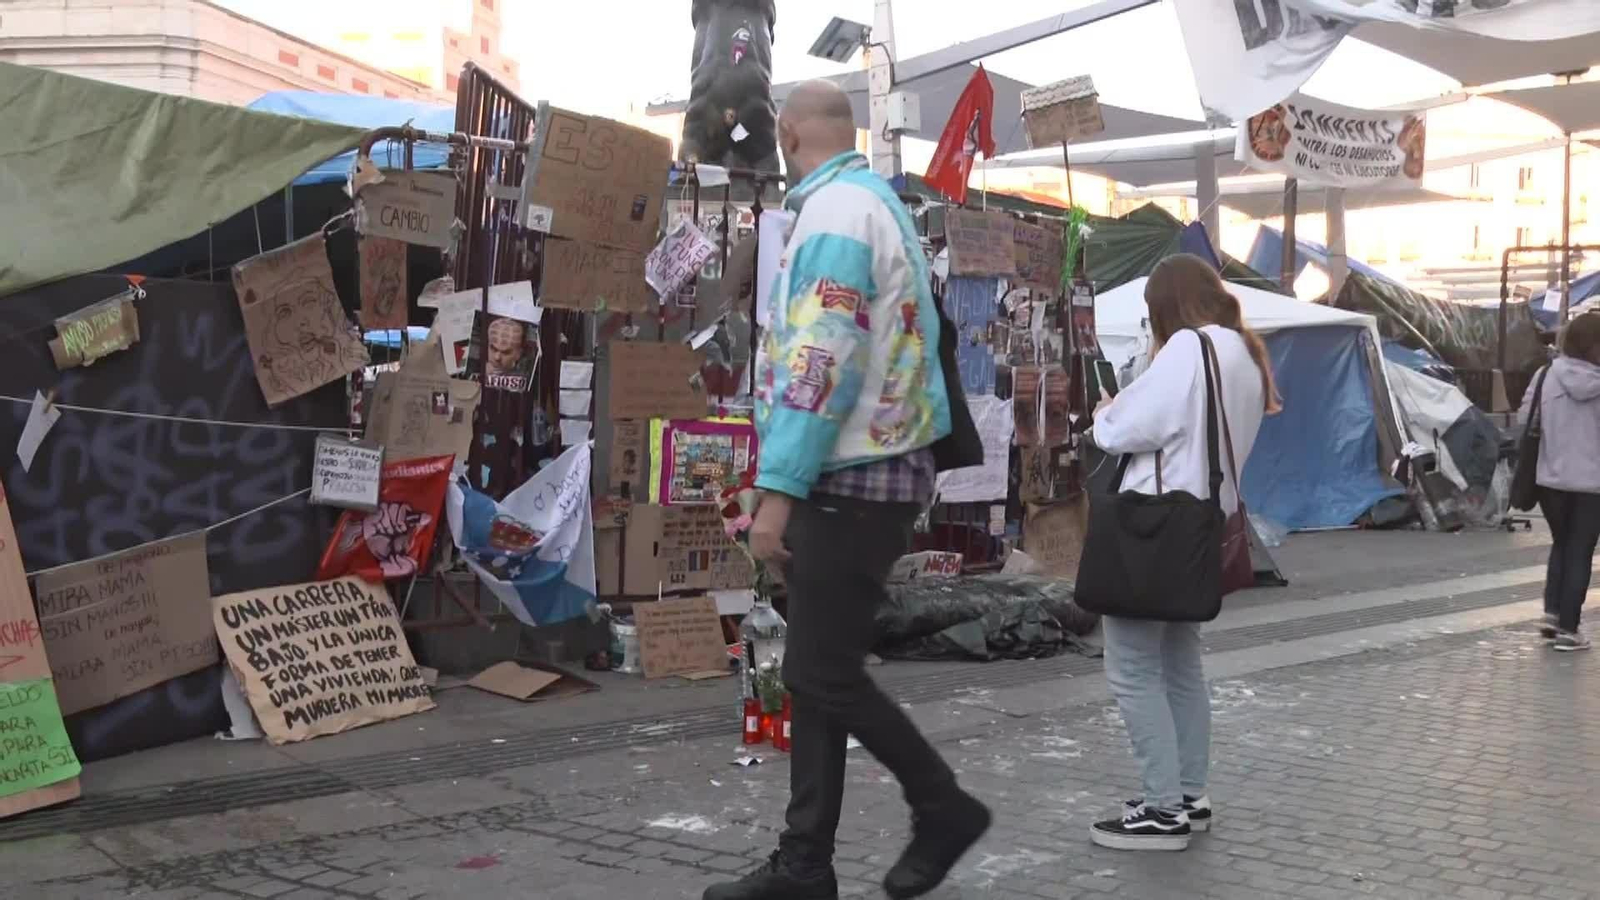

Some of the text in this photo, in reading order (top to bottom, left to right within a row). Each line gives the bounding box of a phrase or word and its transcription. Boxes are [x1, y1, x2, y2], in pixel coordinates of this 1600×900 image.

[1295, 152, 1308, 166] NI
[1331, 143, 1347, 157] LOS
[381, 206, 429, 233] CAMBIO
[221, 599, 272, 629] UNA
[235, 628, 273, 655] UN
[334, 607, 361, 628] UN
[307, 636, 319, 653] Y
[321, 632, 345, 649] LA
[261, 645, 401, 690] FORMA DE TENER
[270, 685, 313, 708] UNA
[283, 690, 362, 729] MURIERA
[365, 689, 386, 706] MI
